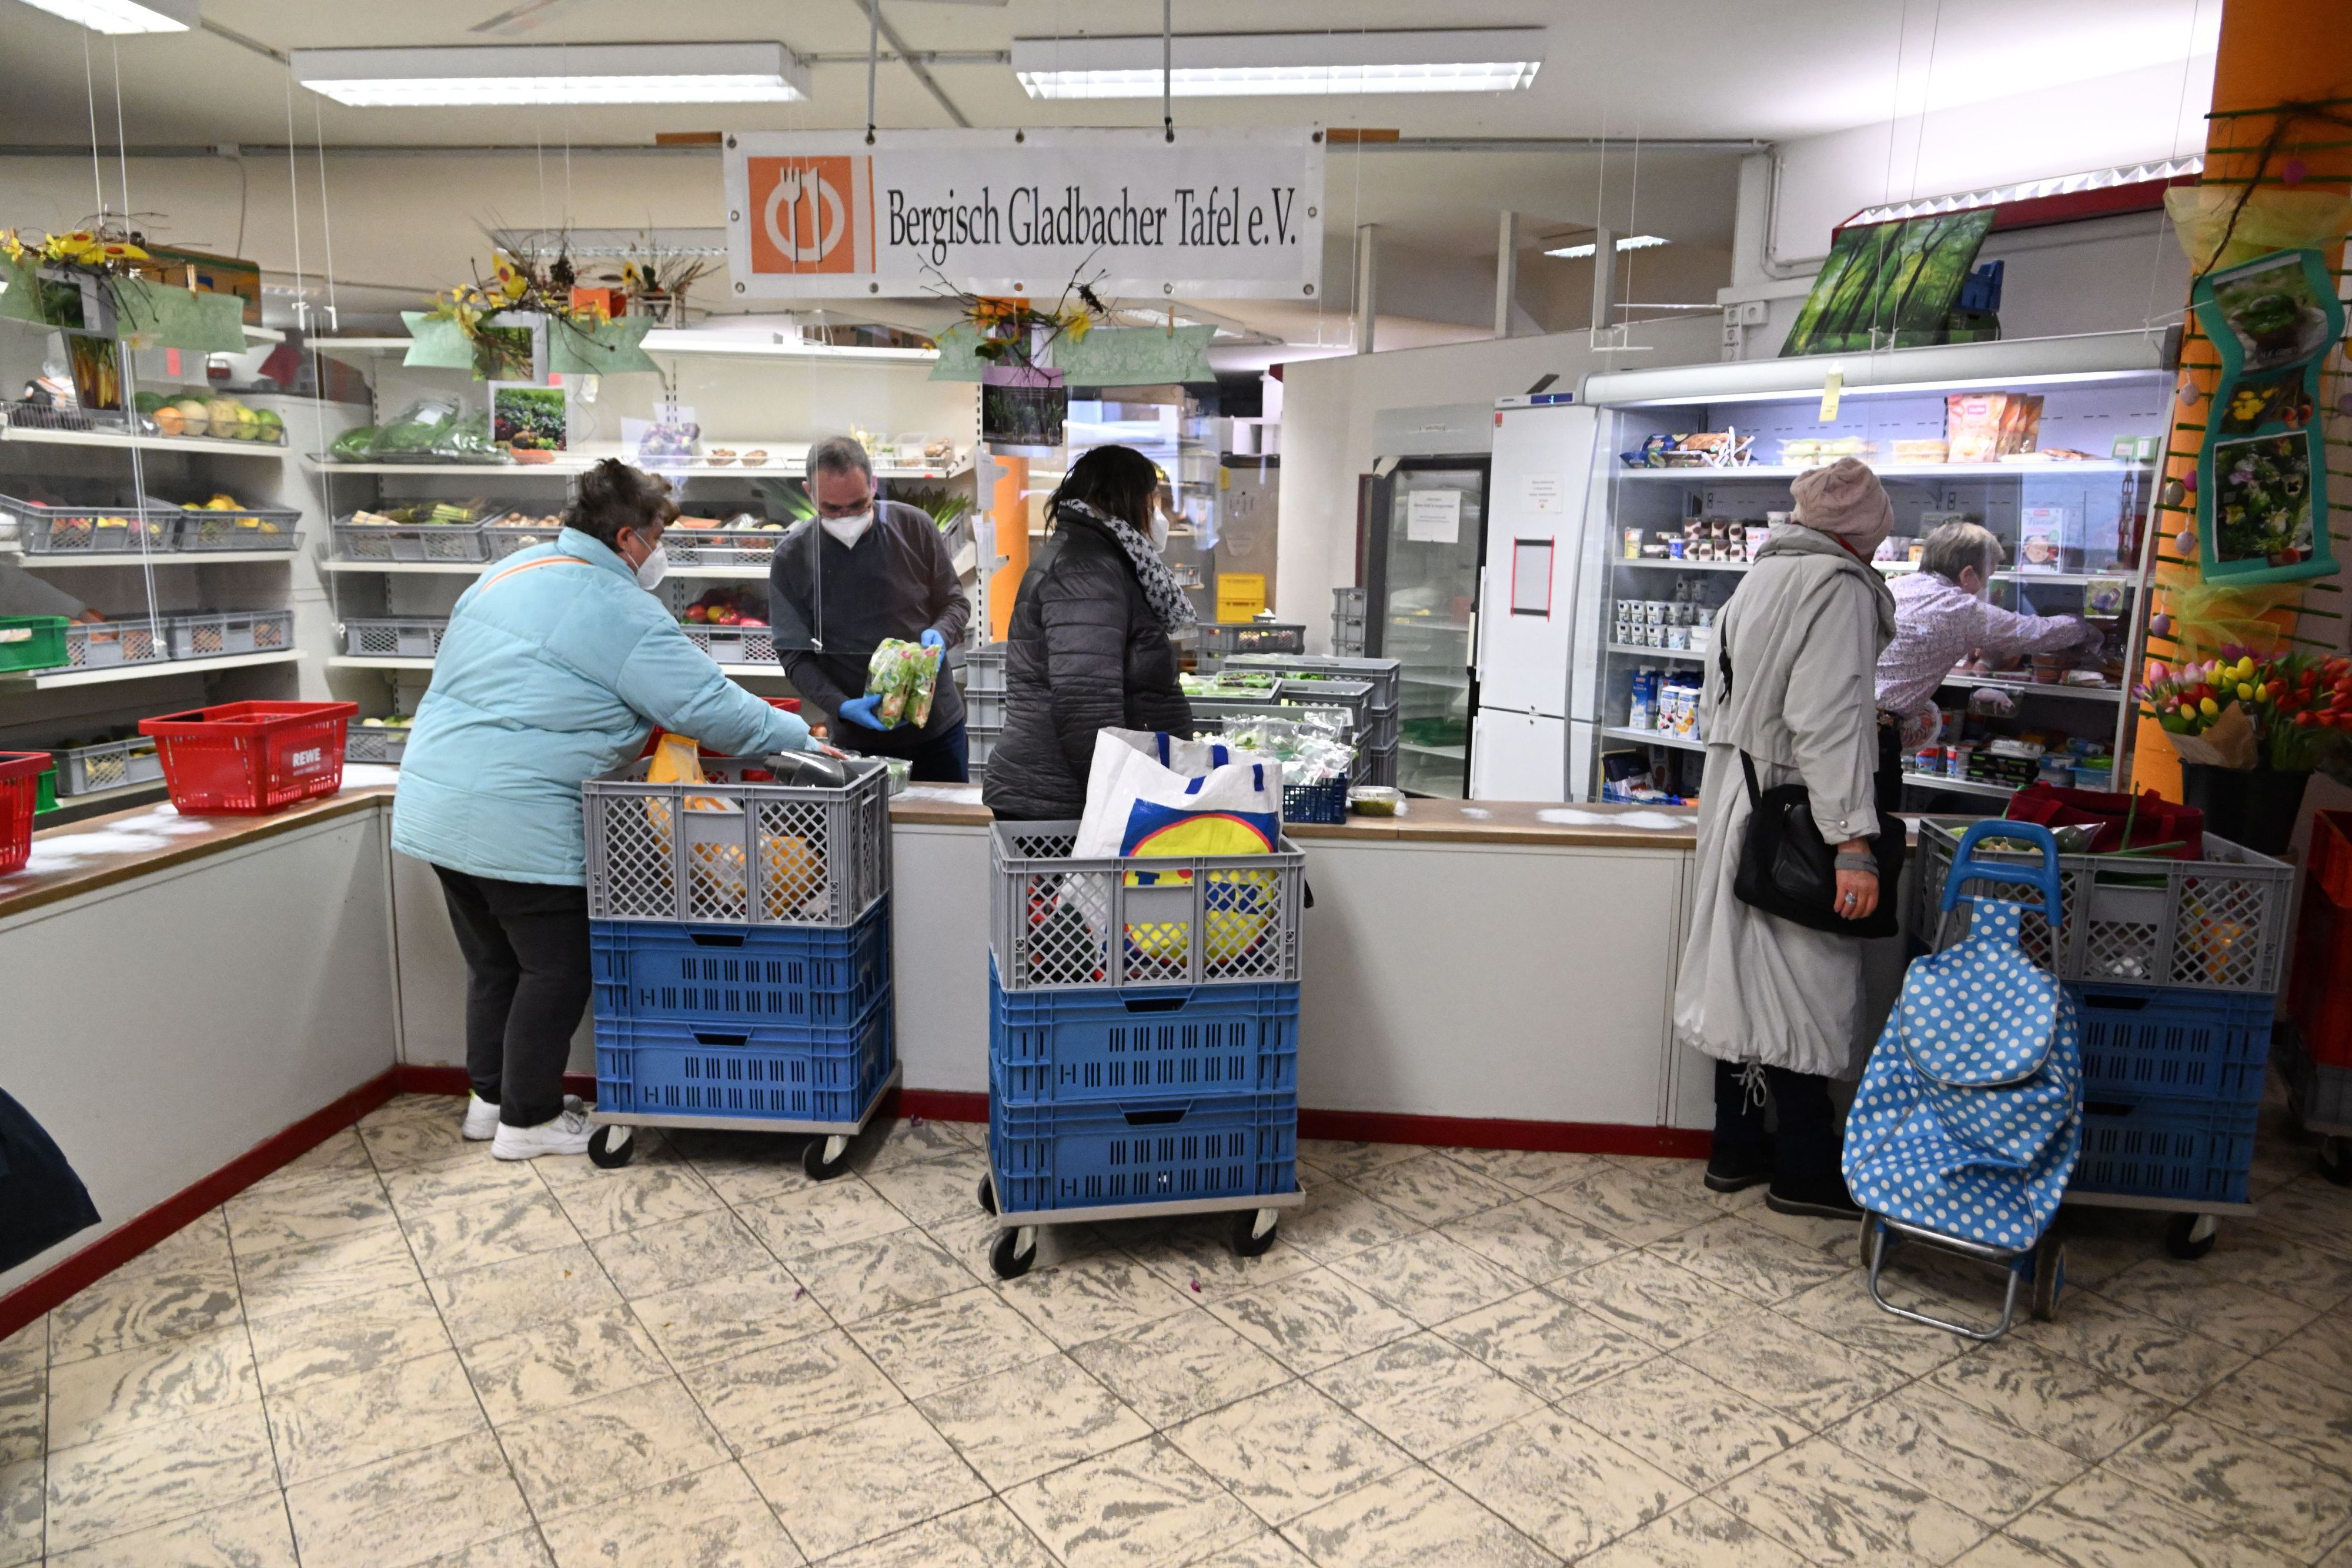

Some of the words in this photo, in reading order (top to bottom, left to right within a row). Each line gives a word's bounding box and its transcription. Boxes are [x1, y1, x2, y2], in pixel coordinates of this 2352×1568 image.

[887, 186, 1001, 266] Bergisch
[1008, 185, 1167, 246] Gladbacher
[1174, 186, 1240, 246] Tafel
[293, 747, 321, 767] REWE
